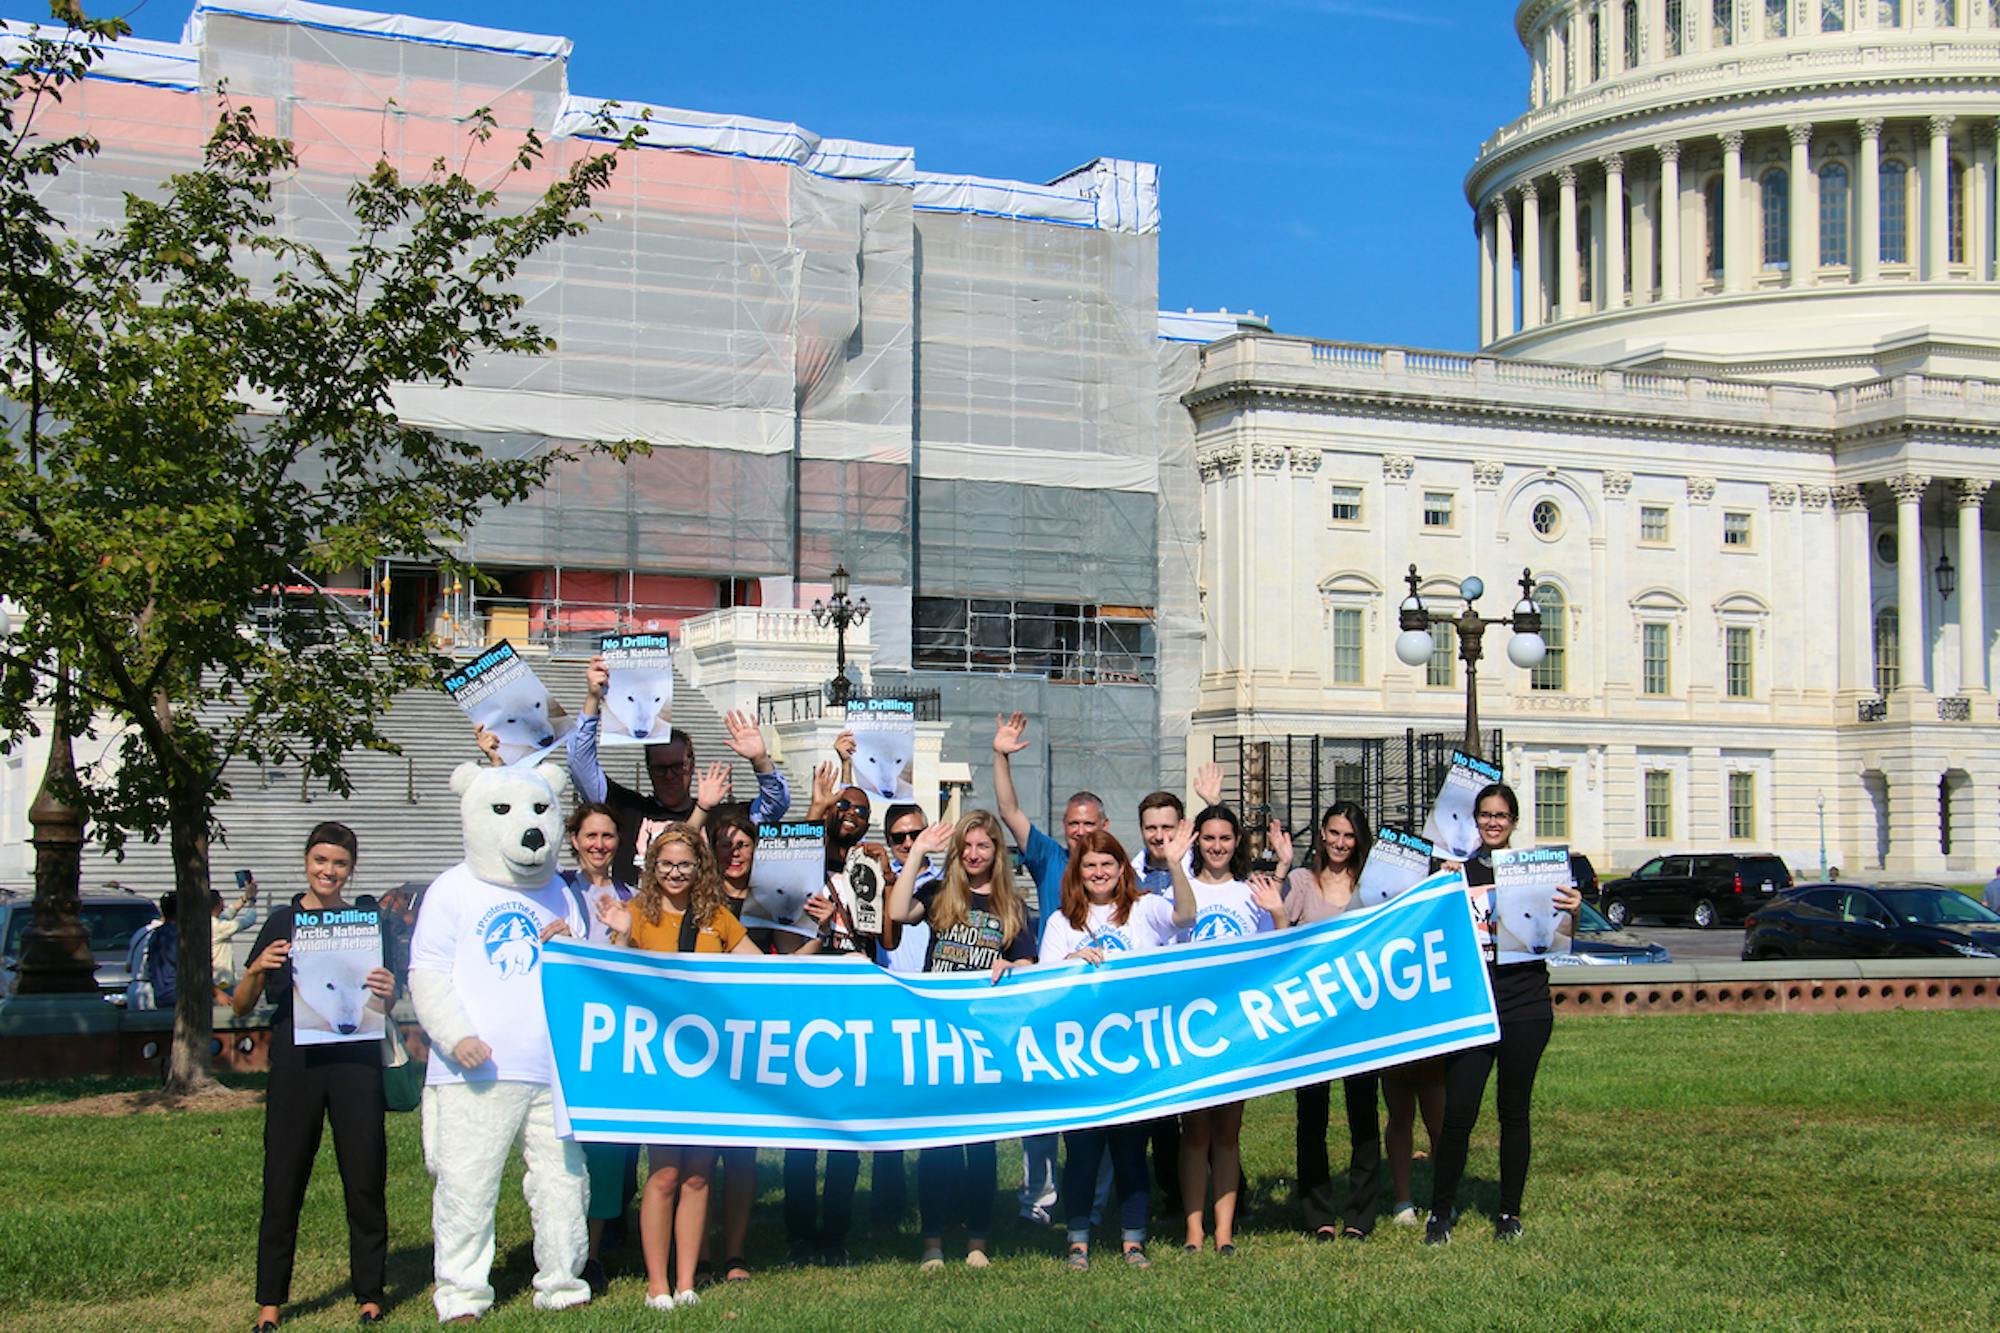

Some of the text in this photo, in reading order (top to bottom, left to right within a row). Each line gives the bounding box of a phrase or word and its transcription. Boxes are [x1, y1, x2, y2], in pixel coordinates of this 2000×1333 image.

[603, 635, 667, 649] No Drilling
[630, 647, 668, 658] National
[445, 644, 513, 692] No Drilling
[454, 654, 519, 702] Arctic National
[847, 699, 914, 712] No Drilling
[847, 711, 914, 721] Arctic National
[1453, 752, 1501, 780] No Drilling
[759, 823, 824, 837] No Drilling
[758, 837, 824, 849] Arctic National
[1379, 828, 1432, 856] No Drilling
[1520, 849, 1567, 863] Drilling
[1498, 862, 1568, 876] Arctic National
[295, 910, 378, 925] No Drilling
[296, 925, 379, 940] Arctic National
[580, 929, 1452, 1089] PROTECT THE ARCTIC REFUGE
